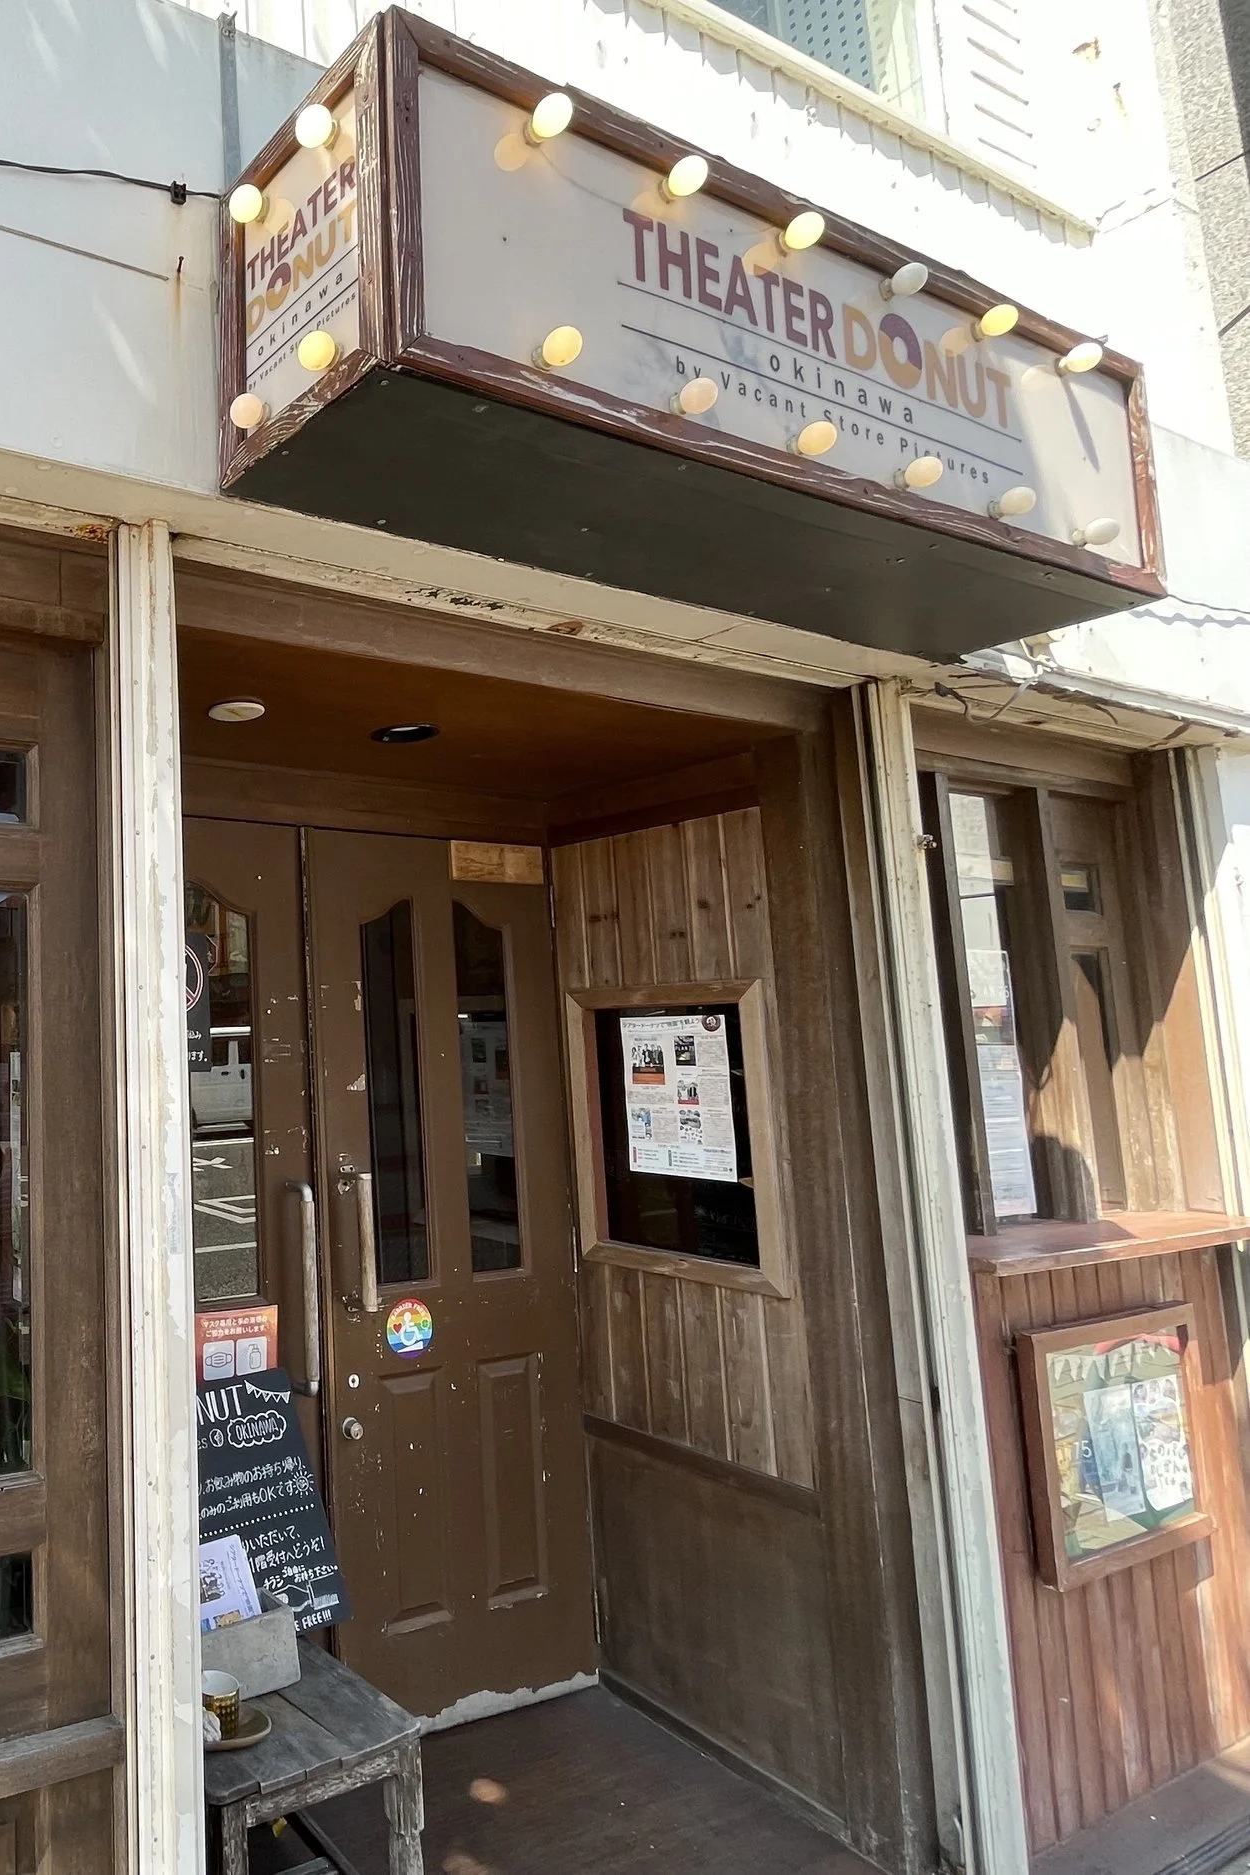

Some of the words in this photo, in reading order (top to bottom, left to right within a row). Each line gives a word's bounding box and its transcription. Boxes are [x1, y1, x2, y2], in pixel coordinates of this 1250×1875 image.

[247, 155, 357, 290] THEATER
[246, 200, 357, 336] DONUT
[258, 272, 343, 356] okinawa
[259, 353, 286, 380] Vacant
[316, 292, 356, 330] Pictures
[622, 207, 837, 359] THEATER
[842, 303, 1011, 429] DONUT
[676, 356, 702, 379] by
[721, 372, 806, 419] Vacant
[823, 409, 885, 447] Store
[769, 354, 914, 426] okinawa
[235, 1417, 279, 1441] OKINAWA
[263, 1575, 284, 1590] チラシ
[302, 1609, 333, 1630] FREE!!!
